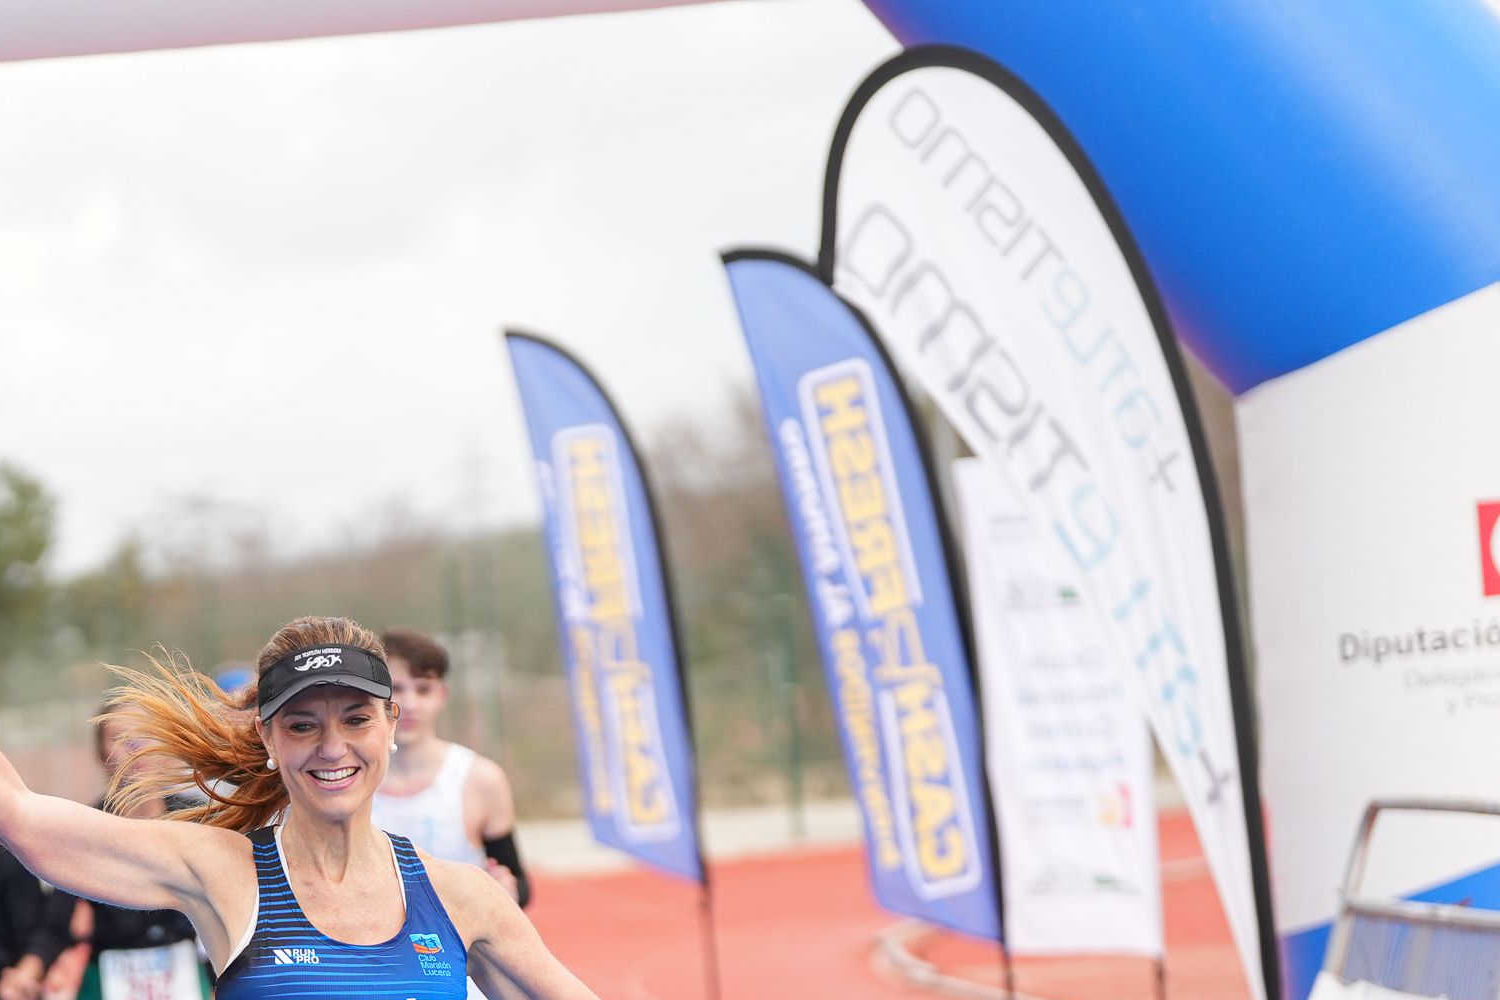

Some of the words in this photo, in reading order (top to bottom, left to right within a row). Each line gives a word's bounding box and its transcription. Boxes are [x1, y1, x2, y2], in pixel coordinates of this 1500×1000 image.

[293, 948, 316, 958] RUN
[297, 955, 320, 964] PRO
[418, 954, 436, 962] Club
[419, 960, 452, 970] Maratón
[422, 968, 452, 977] Lucena
